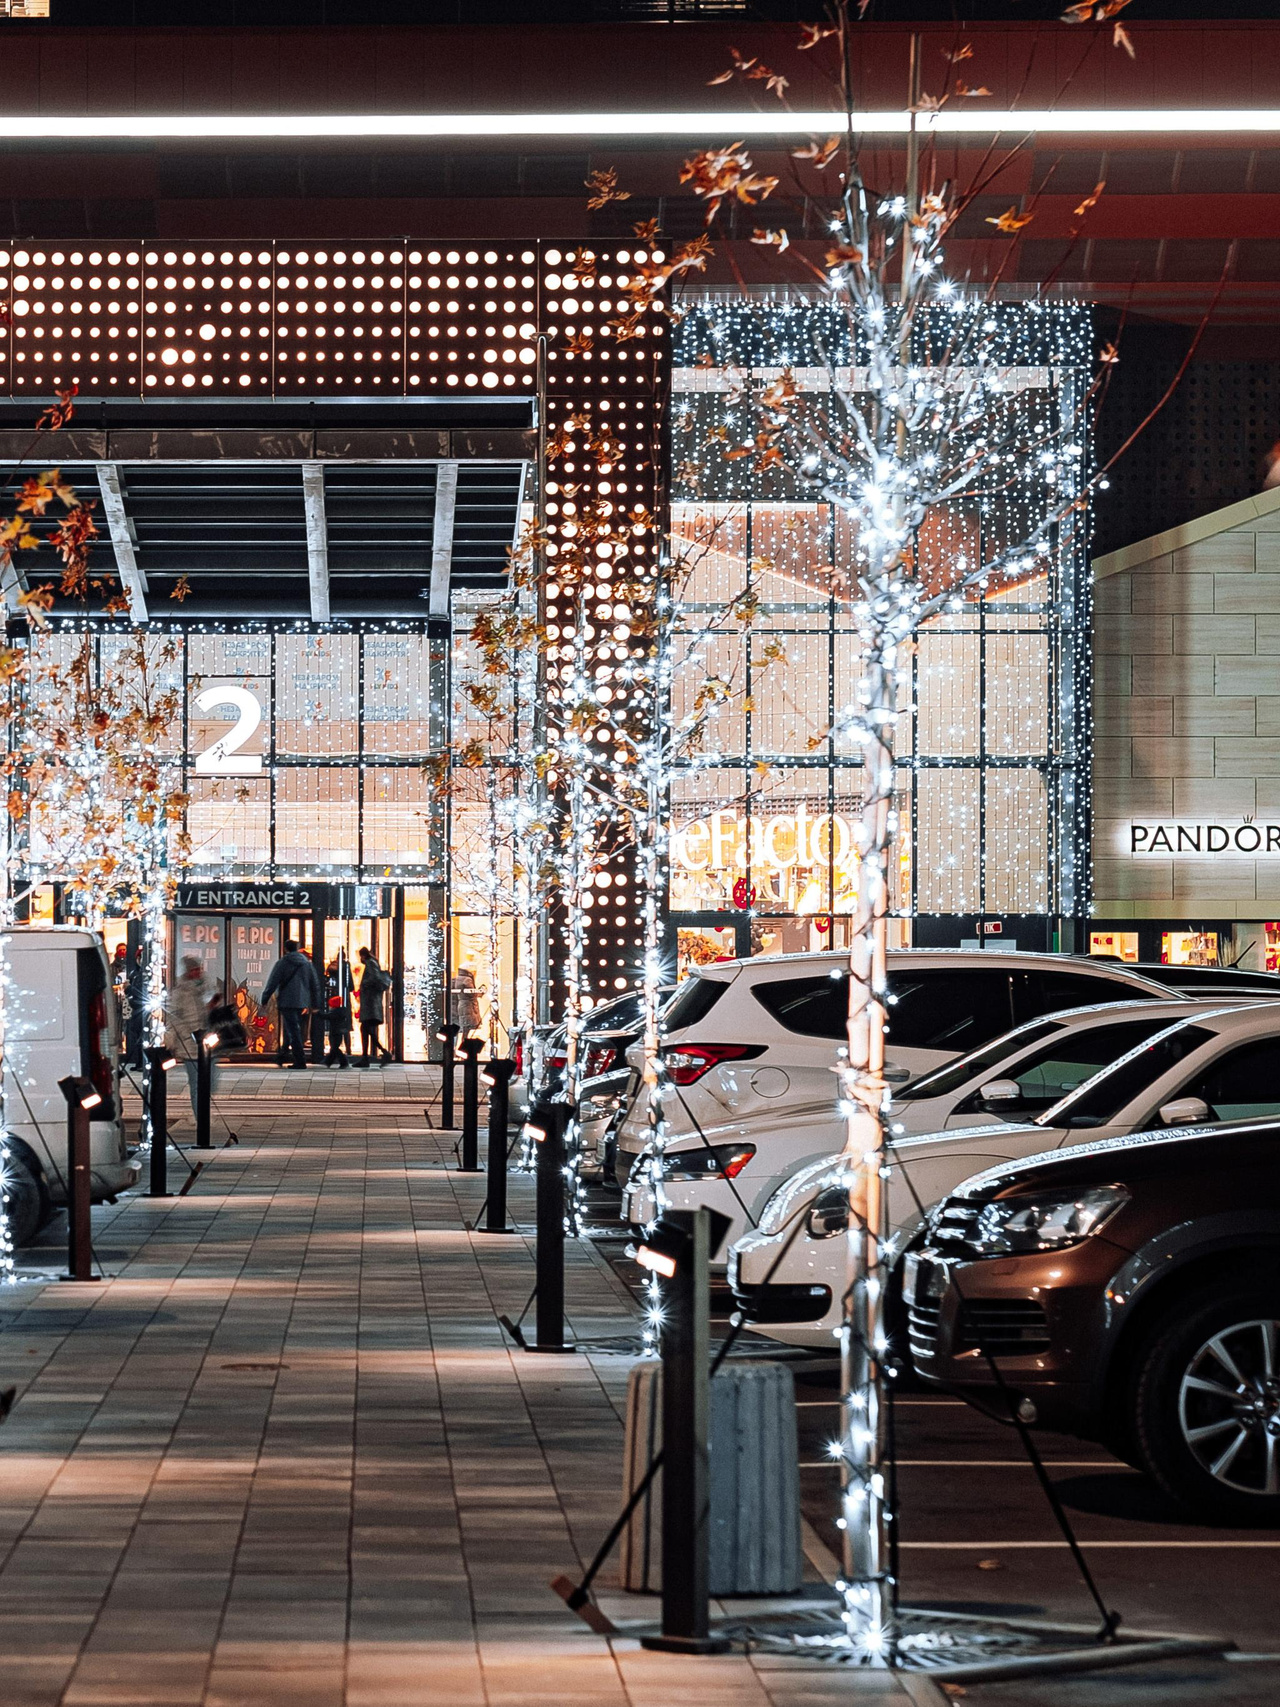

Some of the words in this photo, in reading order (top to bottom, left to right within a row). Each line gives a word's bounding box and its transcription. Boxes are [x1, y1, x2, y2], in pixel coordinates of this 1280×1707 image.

[194, 685, 263, 774] 2
[670, 803, 851, 871] eFacto
[197, 891, 294, 905] ENTRANCE
[300, 891, 310, 905] 2
